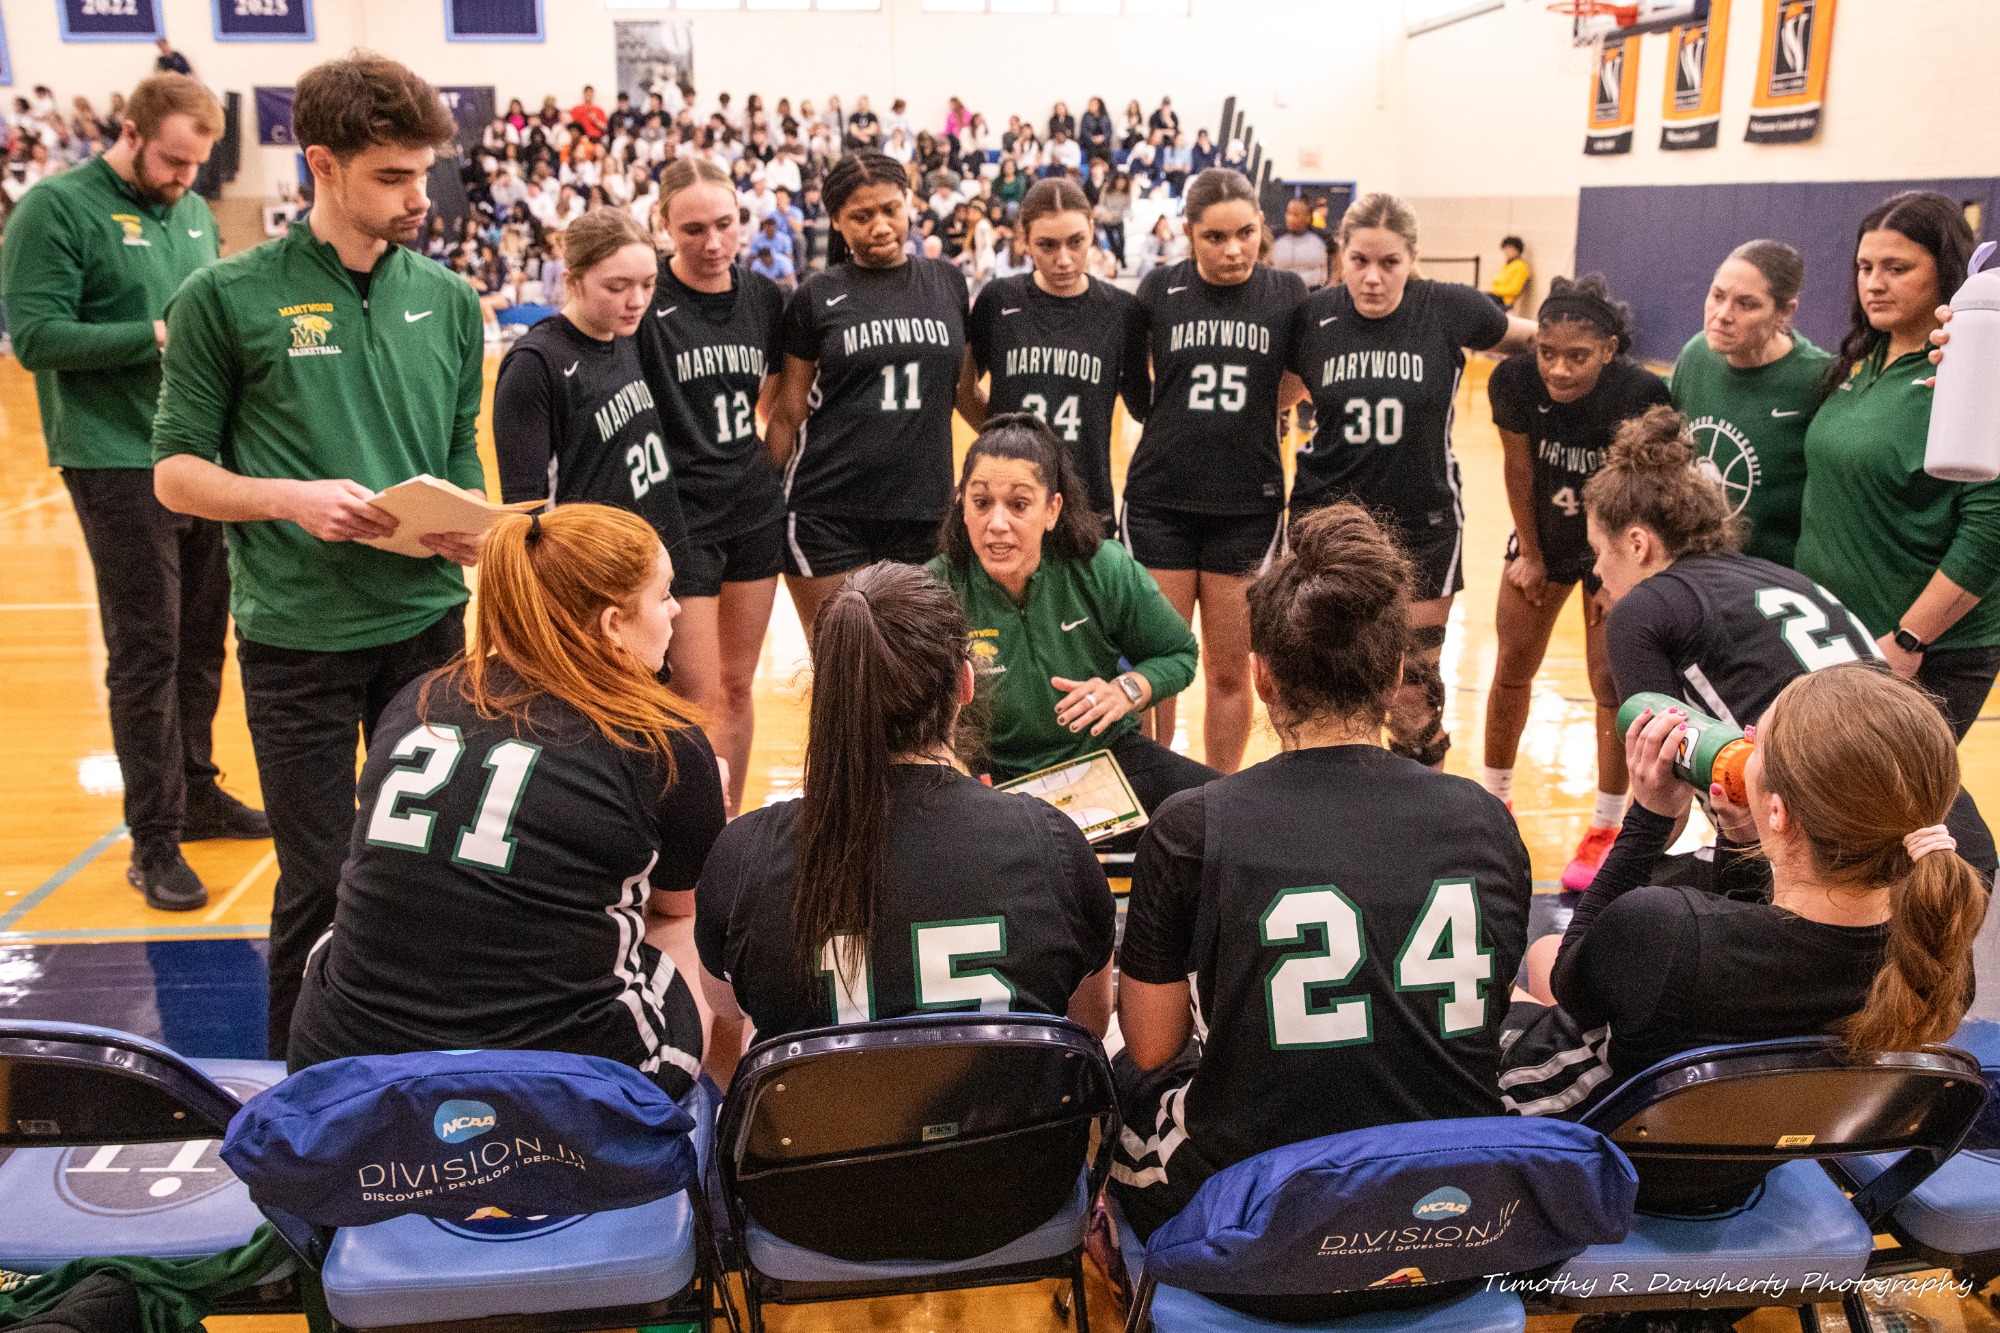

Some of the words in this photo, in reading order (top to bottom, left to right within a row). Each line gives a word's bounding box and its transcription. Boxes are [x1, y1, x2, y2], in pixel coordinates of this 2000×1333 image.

[278, 302, 334, 317] MARYWOOD
[287, 345, 342, 357] BASKETBALL
[843, 318, 949, 356] MARYWOOD
[1170, 319, 1270, 355] MARYWOOD
[676, 344, 766, 383] MARYWOOD
[1006, 346, 1102, 385] MARYWOOD
[1322, 350, 1423, 388] MARYWOOD
[880, 361, 922, 411] 11
[1187, 363, 1248, 413] 25
[594, 379, 654, 442] MARYWOO
[714, 390, 752, 443] 12
[1021, 393, 1082, 441] 34
[1343, 397, 1404, 445] 30
[626, 432, 671, 500] 20
[1719, 418, 1762, 486] UNIVERSITY
[1551, 486, 1580, 517] 4
[365, 722, 543, 874] 21
[813, 915, 1017, 1025] 15
[1258, 876, 1496, 1050] 24
[442, 1115, 495, 1138] NCAA
[358, 1137, 542, 1188] DIVISION
[362, 1187, 433, 1202] DISCOVER
[448, 1165, 510, 1190] DEVELOP
[1416, 1201, 1468, 1214] NCAA
[1316, 1247, 1382, 1256] DISCOVER
[1394, 1242, 1453, 1252] DEVELOP
[1320, 1220, 1491, 1250] DIVISION
